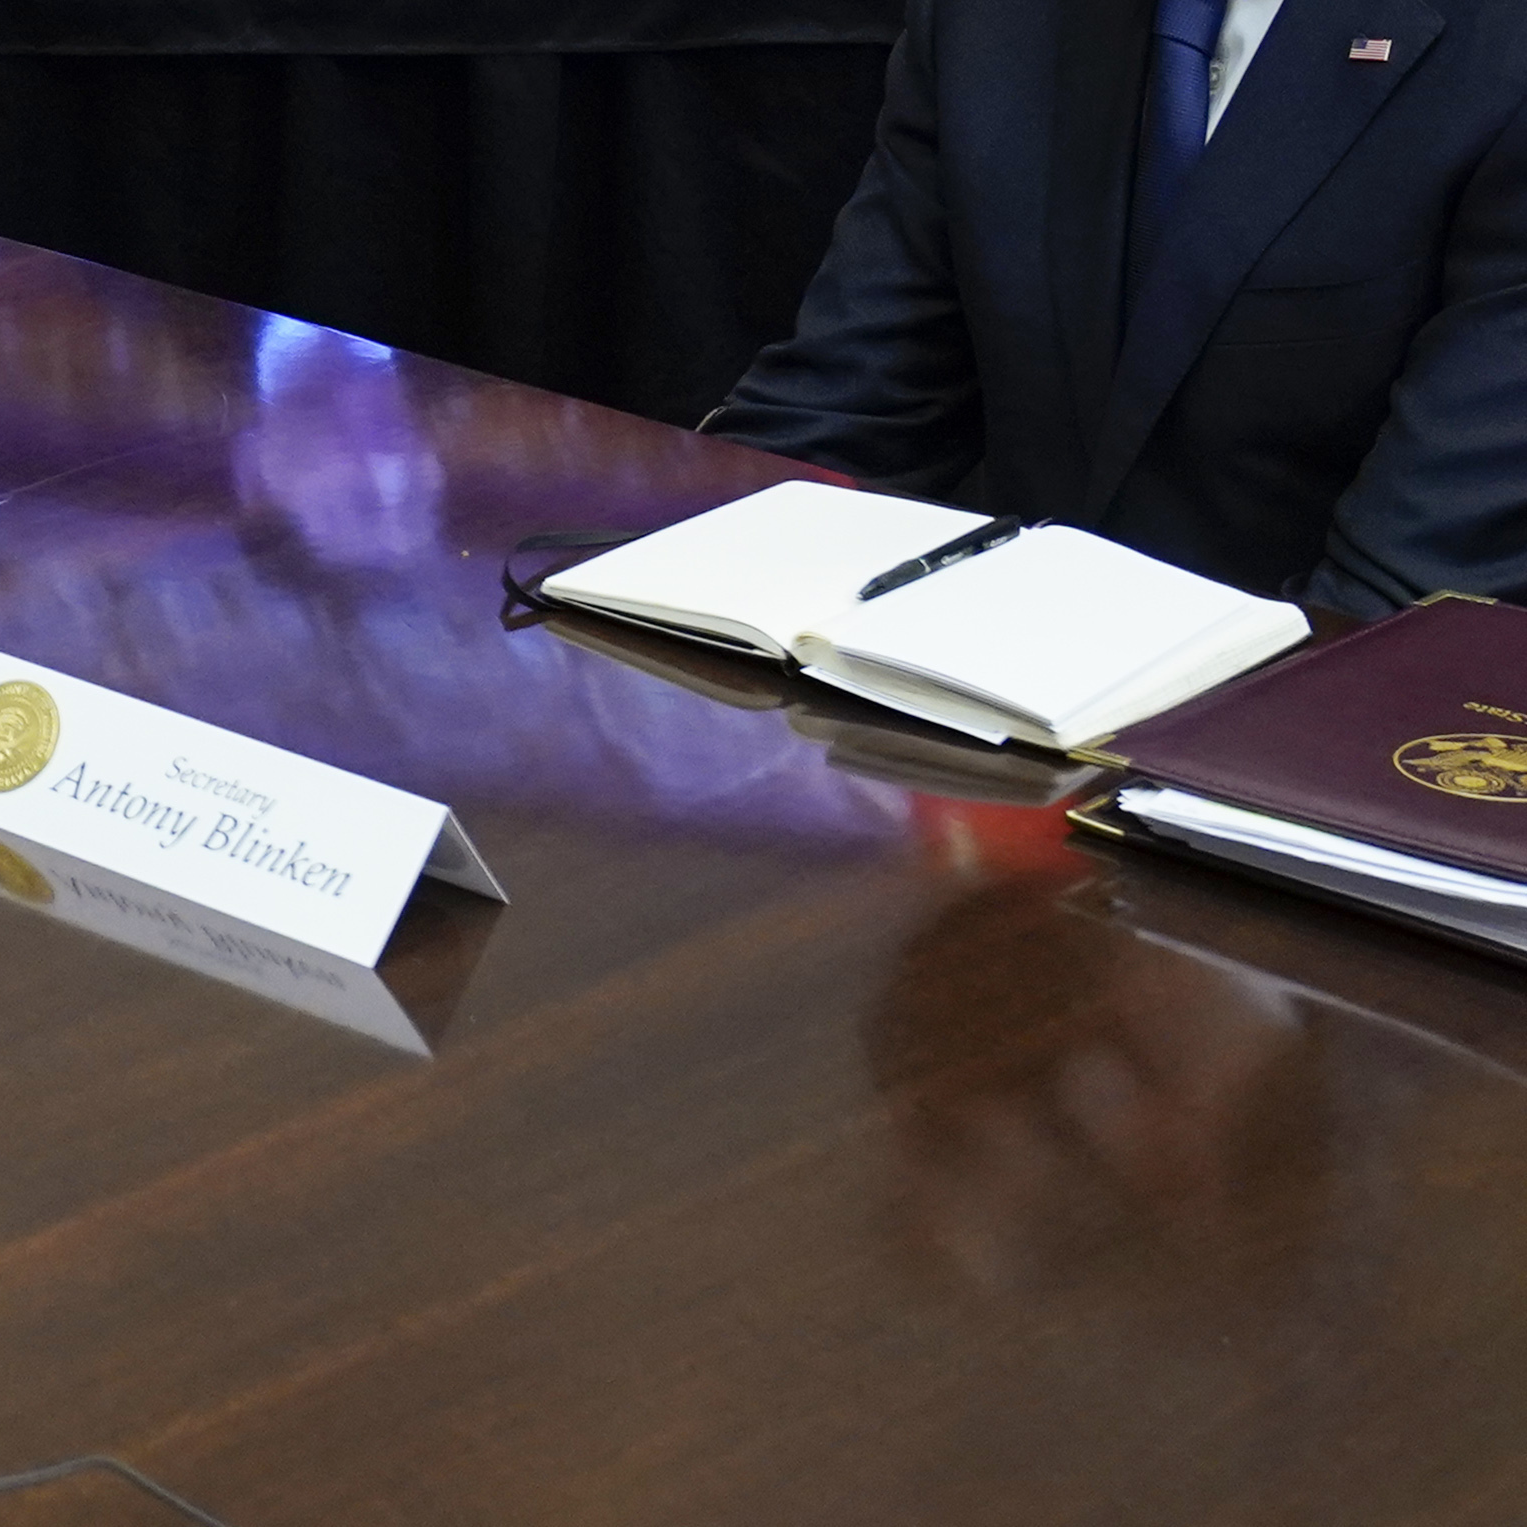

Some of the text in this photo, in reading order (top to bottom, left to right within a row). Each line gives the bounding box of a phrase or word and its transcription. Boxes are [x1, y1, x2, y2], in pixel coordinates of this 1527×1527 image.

[49, 761, 351, 897] Antony Blinken
[164, 756, 277, 820] Secretary
